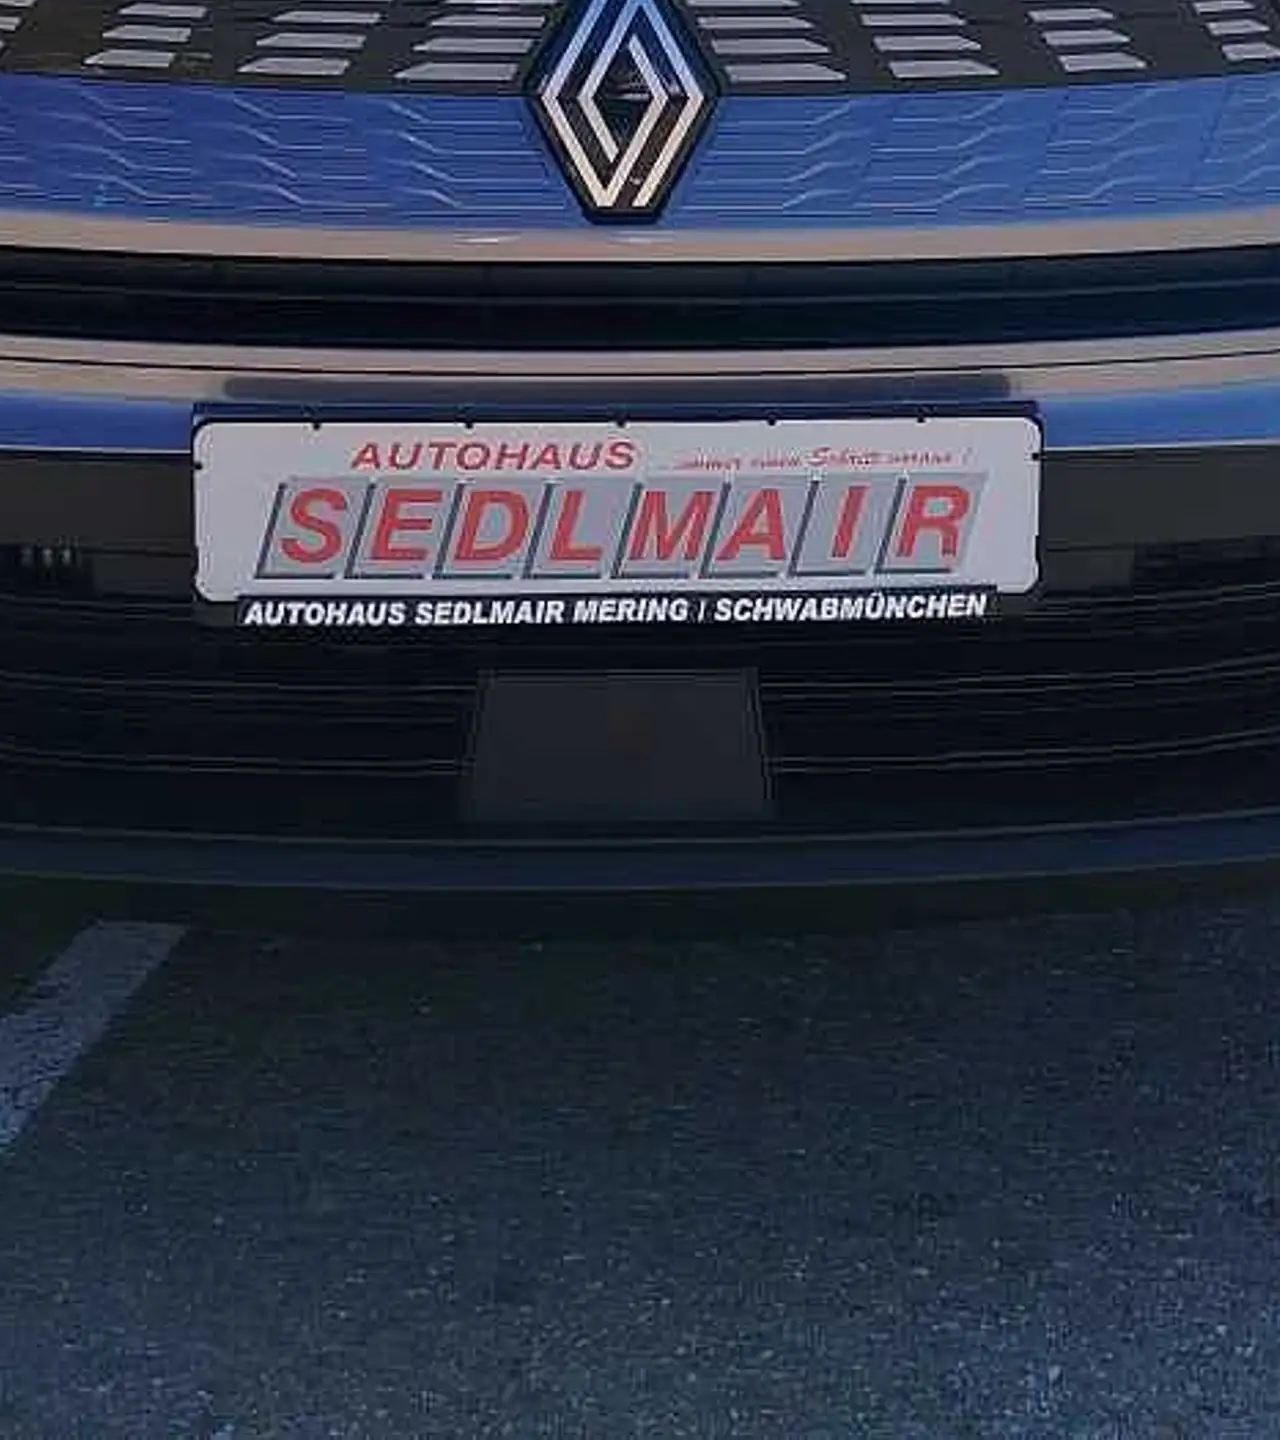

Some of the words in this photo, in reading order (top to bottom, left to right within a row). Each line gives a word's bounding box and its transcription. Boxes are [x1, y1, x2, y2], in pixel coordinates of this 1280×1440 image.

[350, 441, 636, 471] AUTOHAUS
[280, 484, 971, 564] SEDLMAIR
[244, 601, 406, 626] AUTOHAUS
[414, 600, 565, 625] SEDLMAIR
[573, 597, 689, 623] MERING
[714, 593, 988, 622] SCHWABMÜNCHEN
